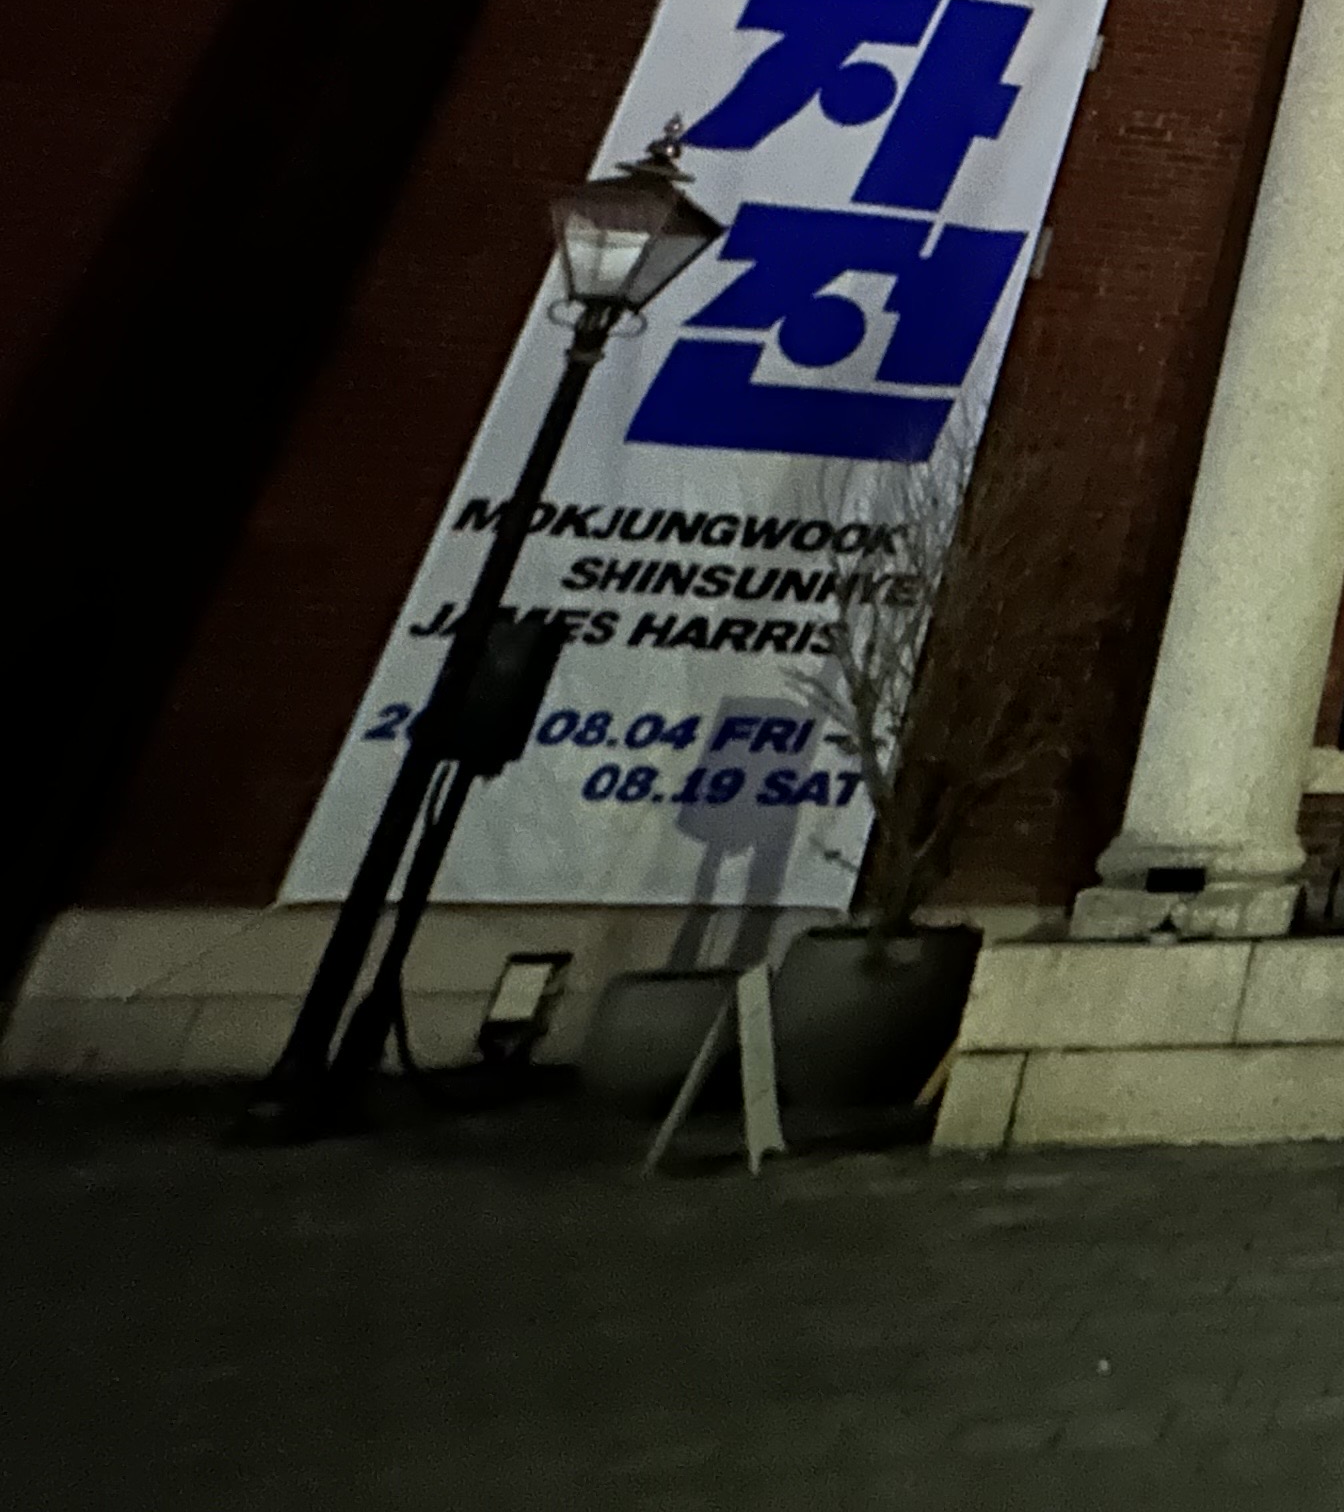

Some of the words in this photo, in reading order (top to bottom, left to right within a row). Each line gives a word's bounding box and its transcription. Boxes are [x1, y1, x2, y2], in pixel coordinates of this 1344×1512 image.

[536, 708, 702, 751] 08.04
[709, 715, 817, 753] FRI
[581, 762, 746, 805] 08.19
[755, 768, 866, 807] SAT
